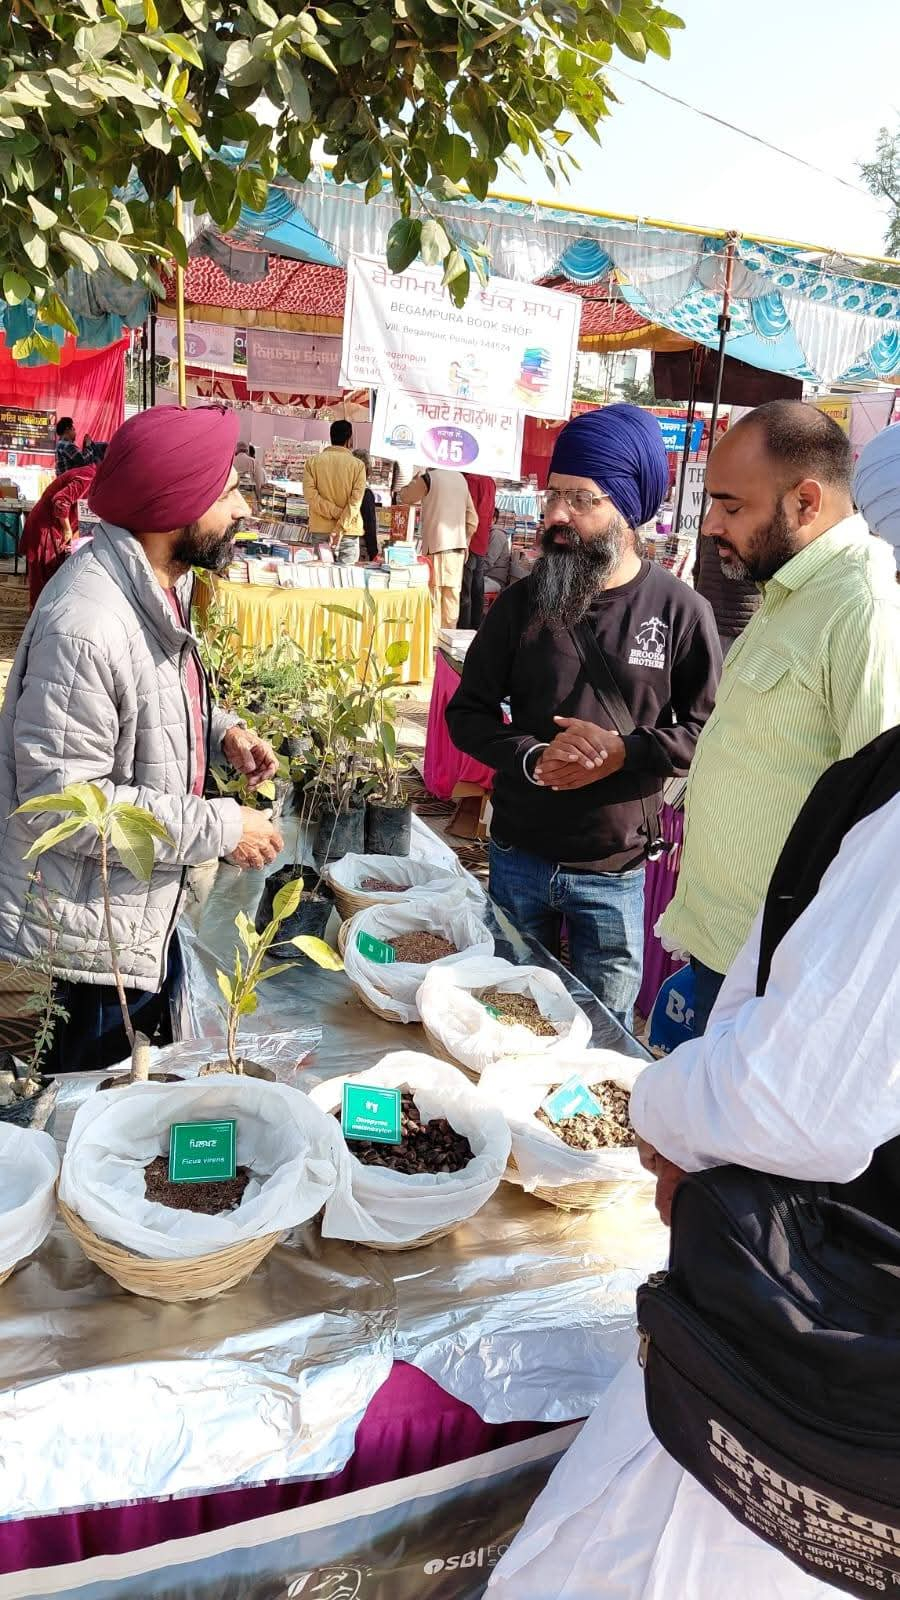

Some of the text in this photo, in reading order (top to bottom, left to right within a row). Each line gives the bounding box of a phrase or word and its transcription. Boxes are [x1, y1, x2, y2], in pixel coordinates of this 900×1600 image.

[390, 301, 533, 337] BEGAMPURA BOOK SHOP
[436, 439, 464, 463] 45
[181, 1158, 201, 1166] Ficus
[760, 1482, 794, 1514] का
[444, 1547, 484, 1570] SBI
